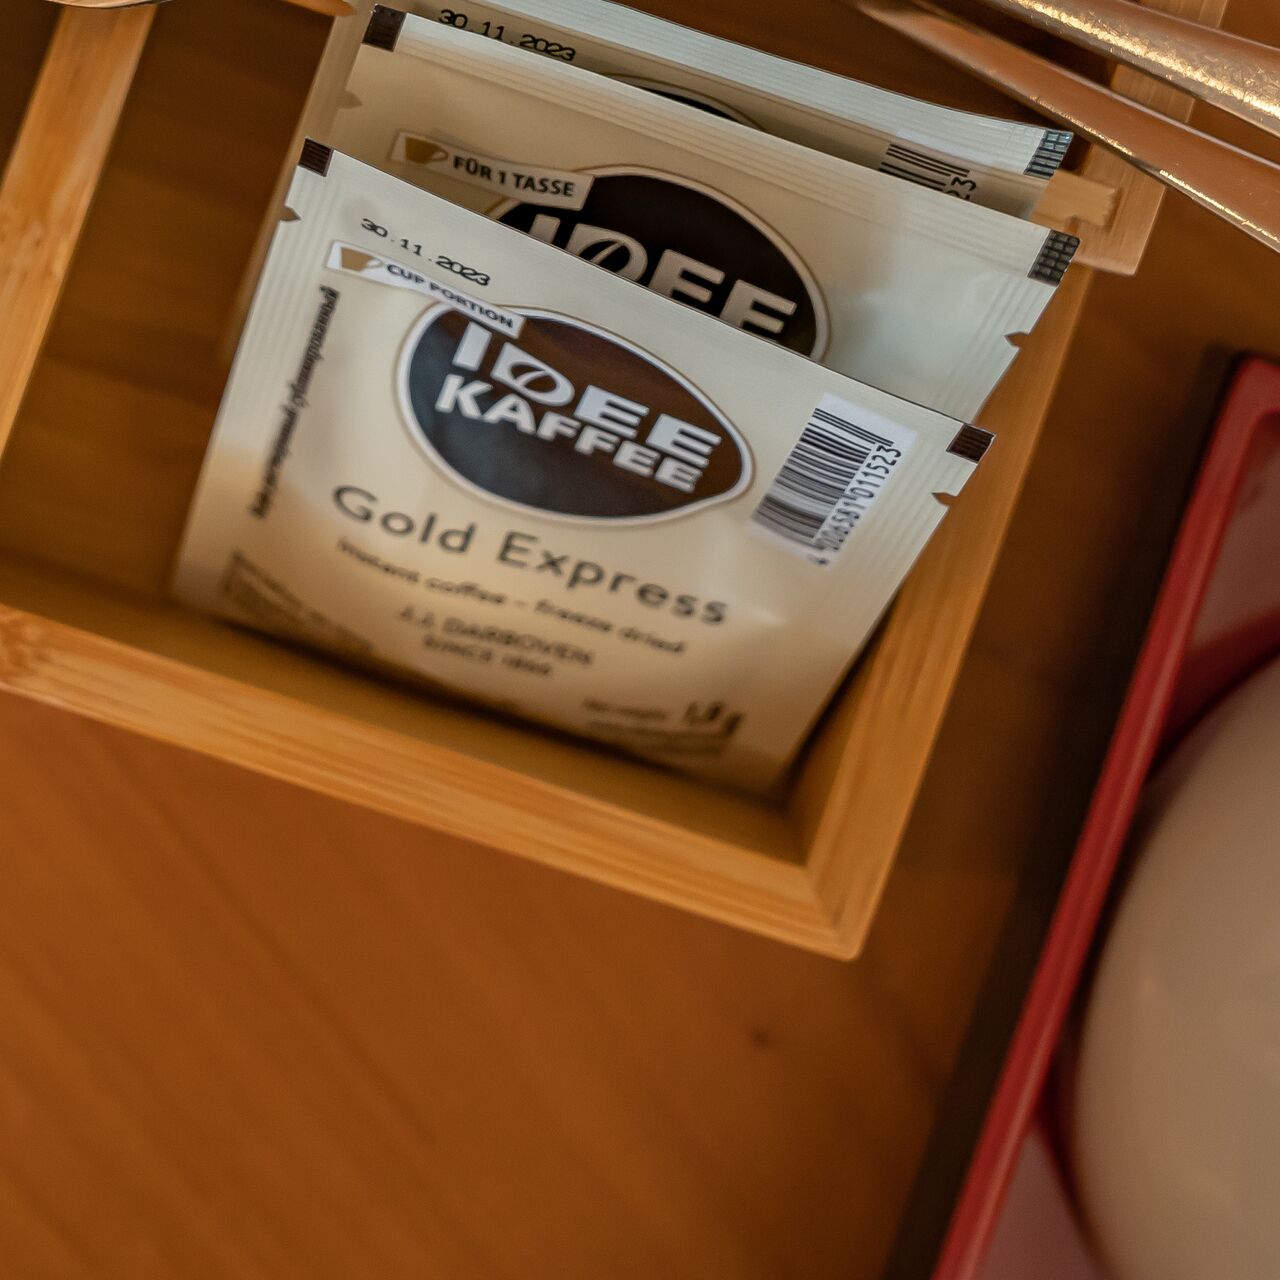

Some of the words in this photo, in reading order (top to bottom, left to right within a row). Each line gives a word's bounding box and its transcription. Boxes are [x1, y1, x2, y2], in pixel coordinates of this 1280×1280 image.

[453, 154, 492, 182] FÜR
[513, 172, 577, 197] TASSE
[360, 217, 491, 287] 30.11.2023
[386, 262, 426, 285] CUP
[429, 281, 514, 330] PORTION
[434, 373, 703, 494] KAFFEE
[332, 484, 477, 554] Gold
[497, 530, 729, 625] Express
